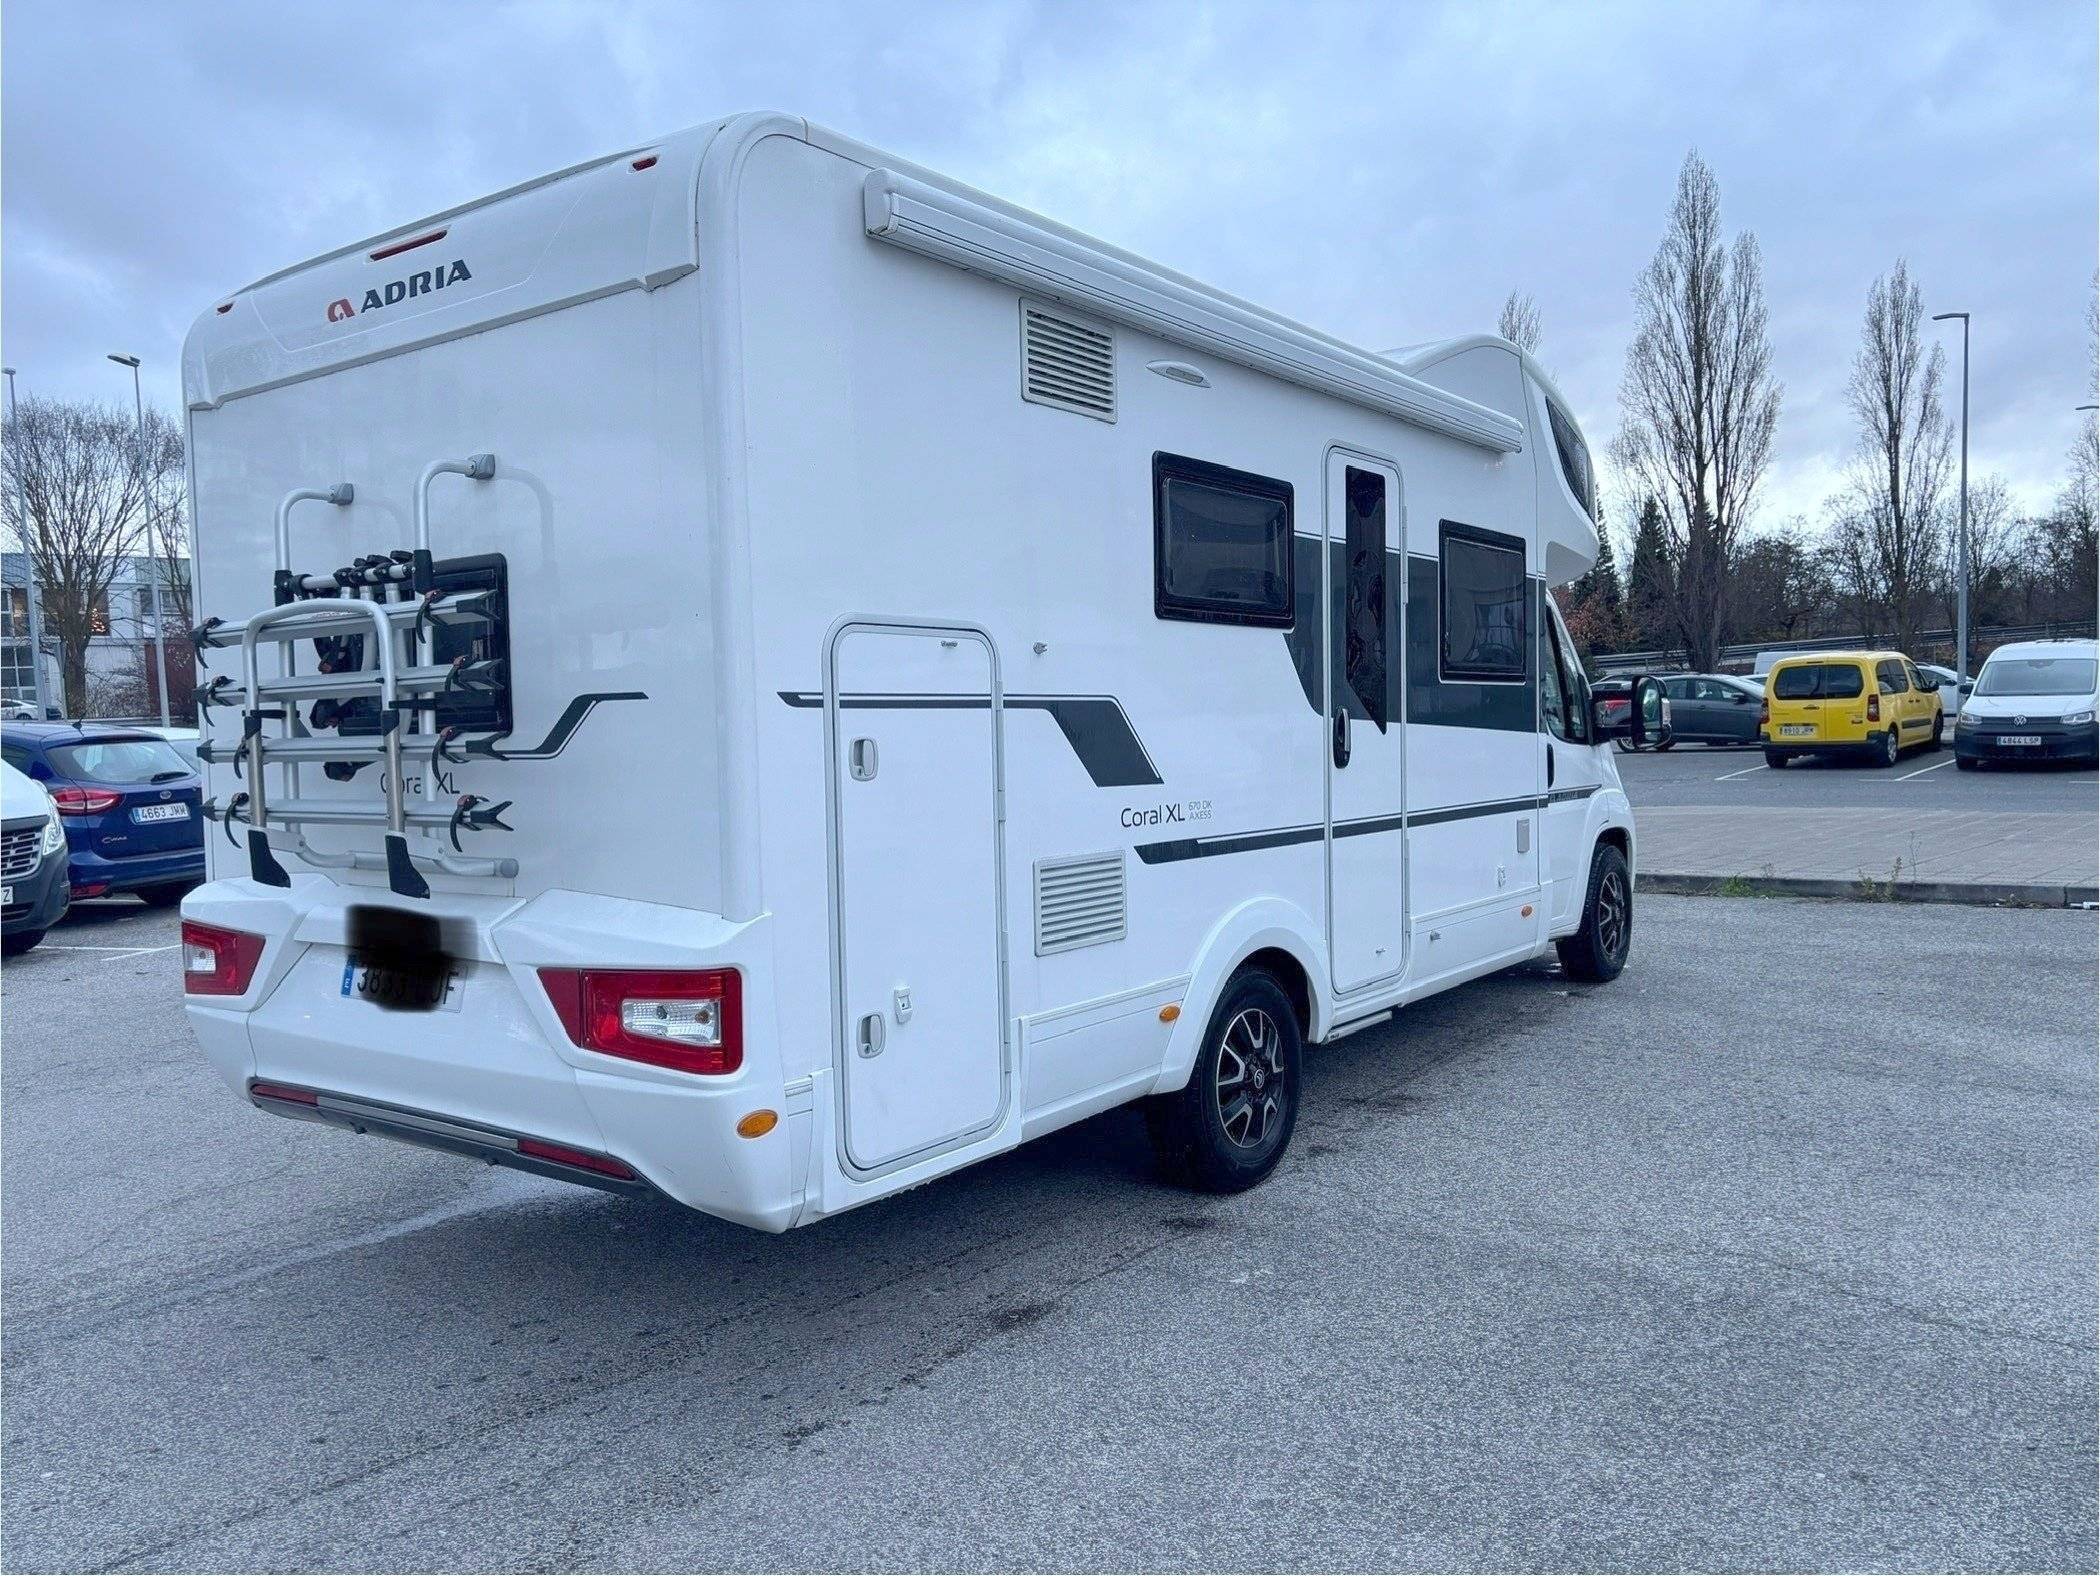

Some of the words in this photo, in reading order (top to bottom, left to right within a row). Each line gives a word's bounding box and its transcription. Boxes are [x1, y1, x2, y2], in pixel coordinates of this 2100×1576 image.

[360, 259, 472, 314] ADRIA
[437, 771, 460, 794] XL
[141, 807, 166, 819] 4663
[1120, 804, 1162, 828] Coral
[1165, 803, 1186, 823] XL
